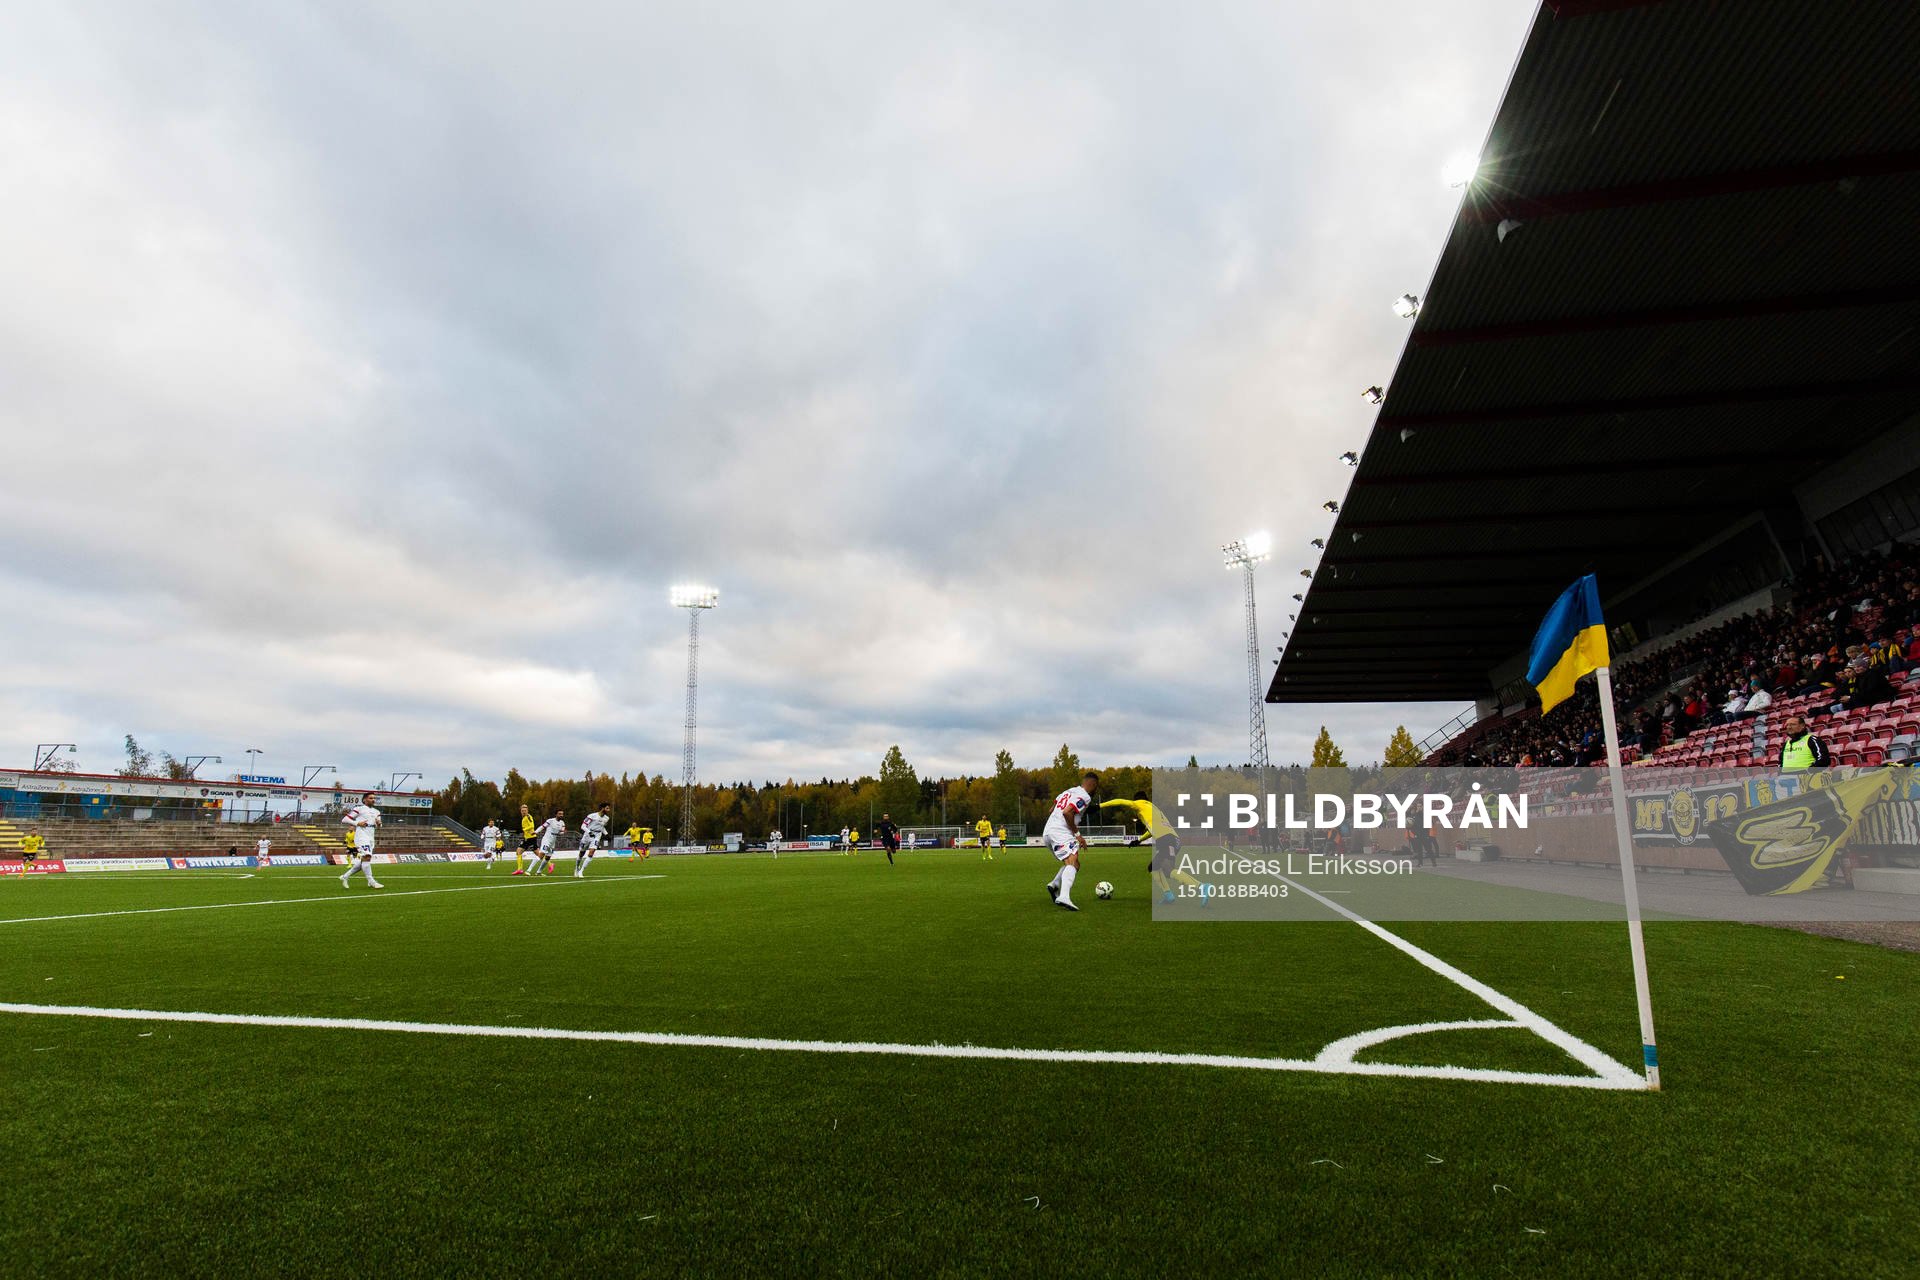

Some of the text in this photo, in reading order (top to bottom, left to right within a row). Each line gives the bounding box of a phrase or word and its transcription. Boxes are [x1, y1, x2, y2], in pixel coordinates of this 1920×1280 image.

[240, 775, 286, 784] BILTEMA
[22, 783, 59, 792] AstraZeneca
[1635, 799, 1665, 831] MT
[190, 857, 247, 867] STRYKTIPSET
[272, 856, 321, 865] STRYKTIPSET
